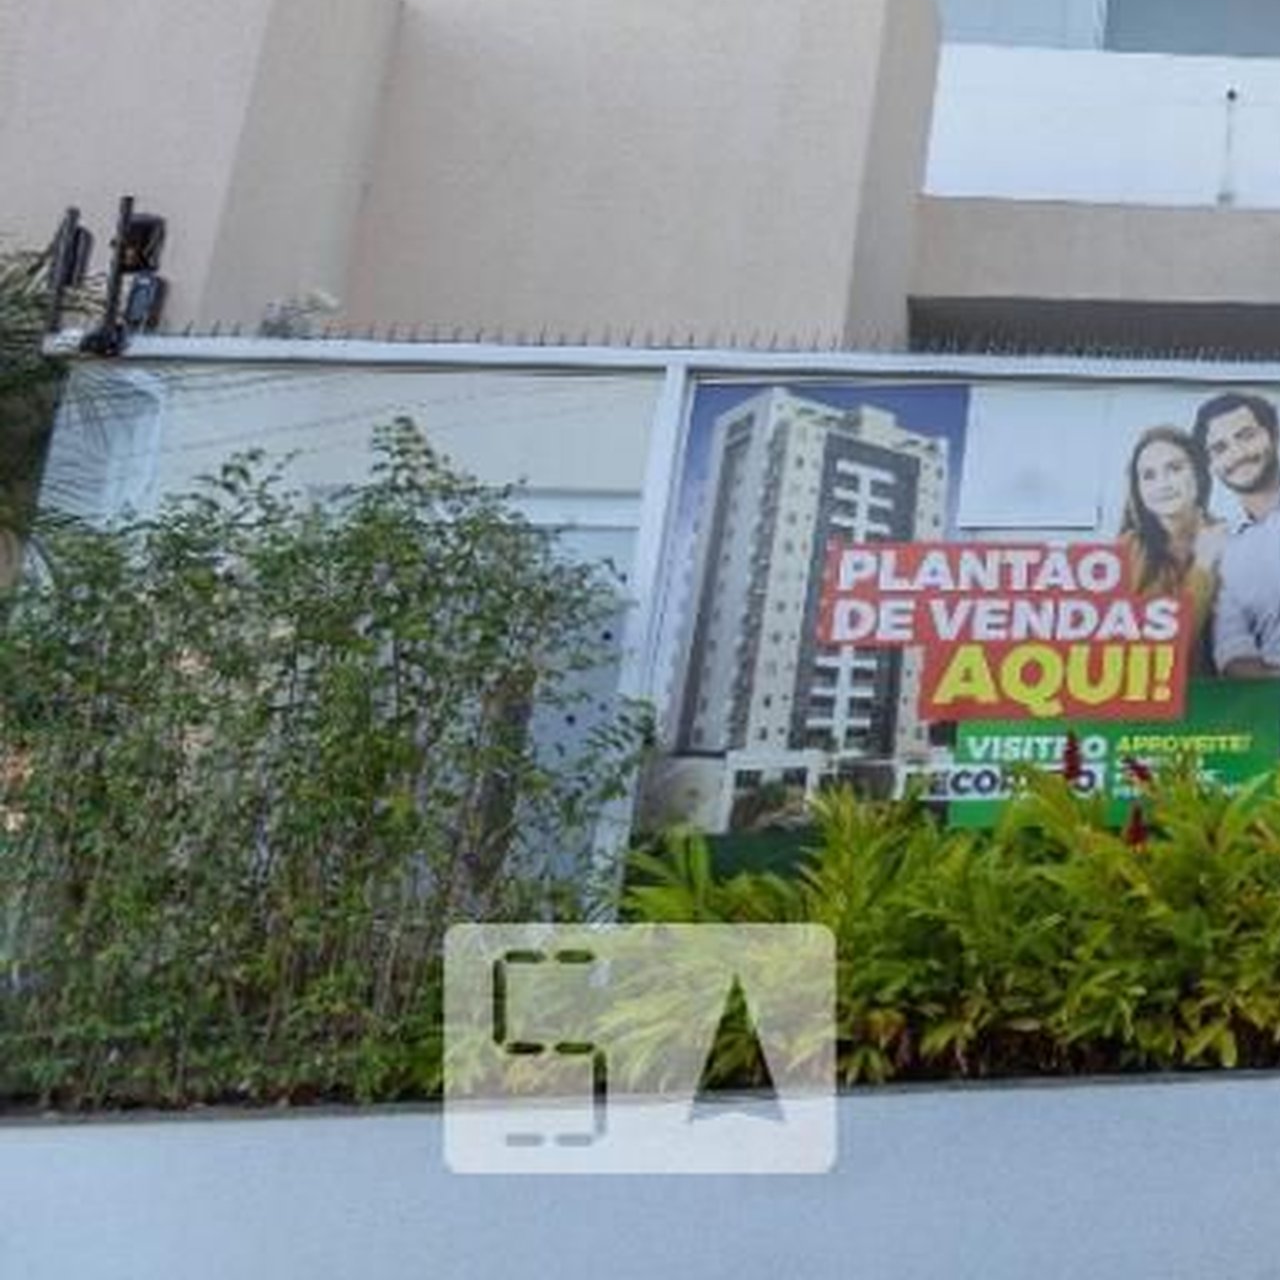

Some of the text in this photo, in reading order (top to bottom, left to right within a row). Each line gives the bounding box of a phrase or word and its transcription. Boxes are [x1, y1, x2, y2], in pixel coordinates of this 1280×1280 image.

[837, 541, 1122, 592] PLANTÃO
[832, 598, 1181, 641] DE VENDAS
[932, 643, 1176, 718] AQUI!
[1081, 736, 1108, 760] O
